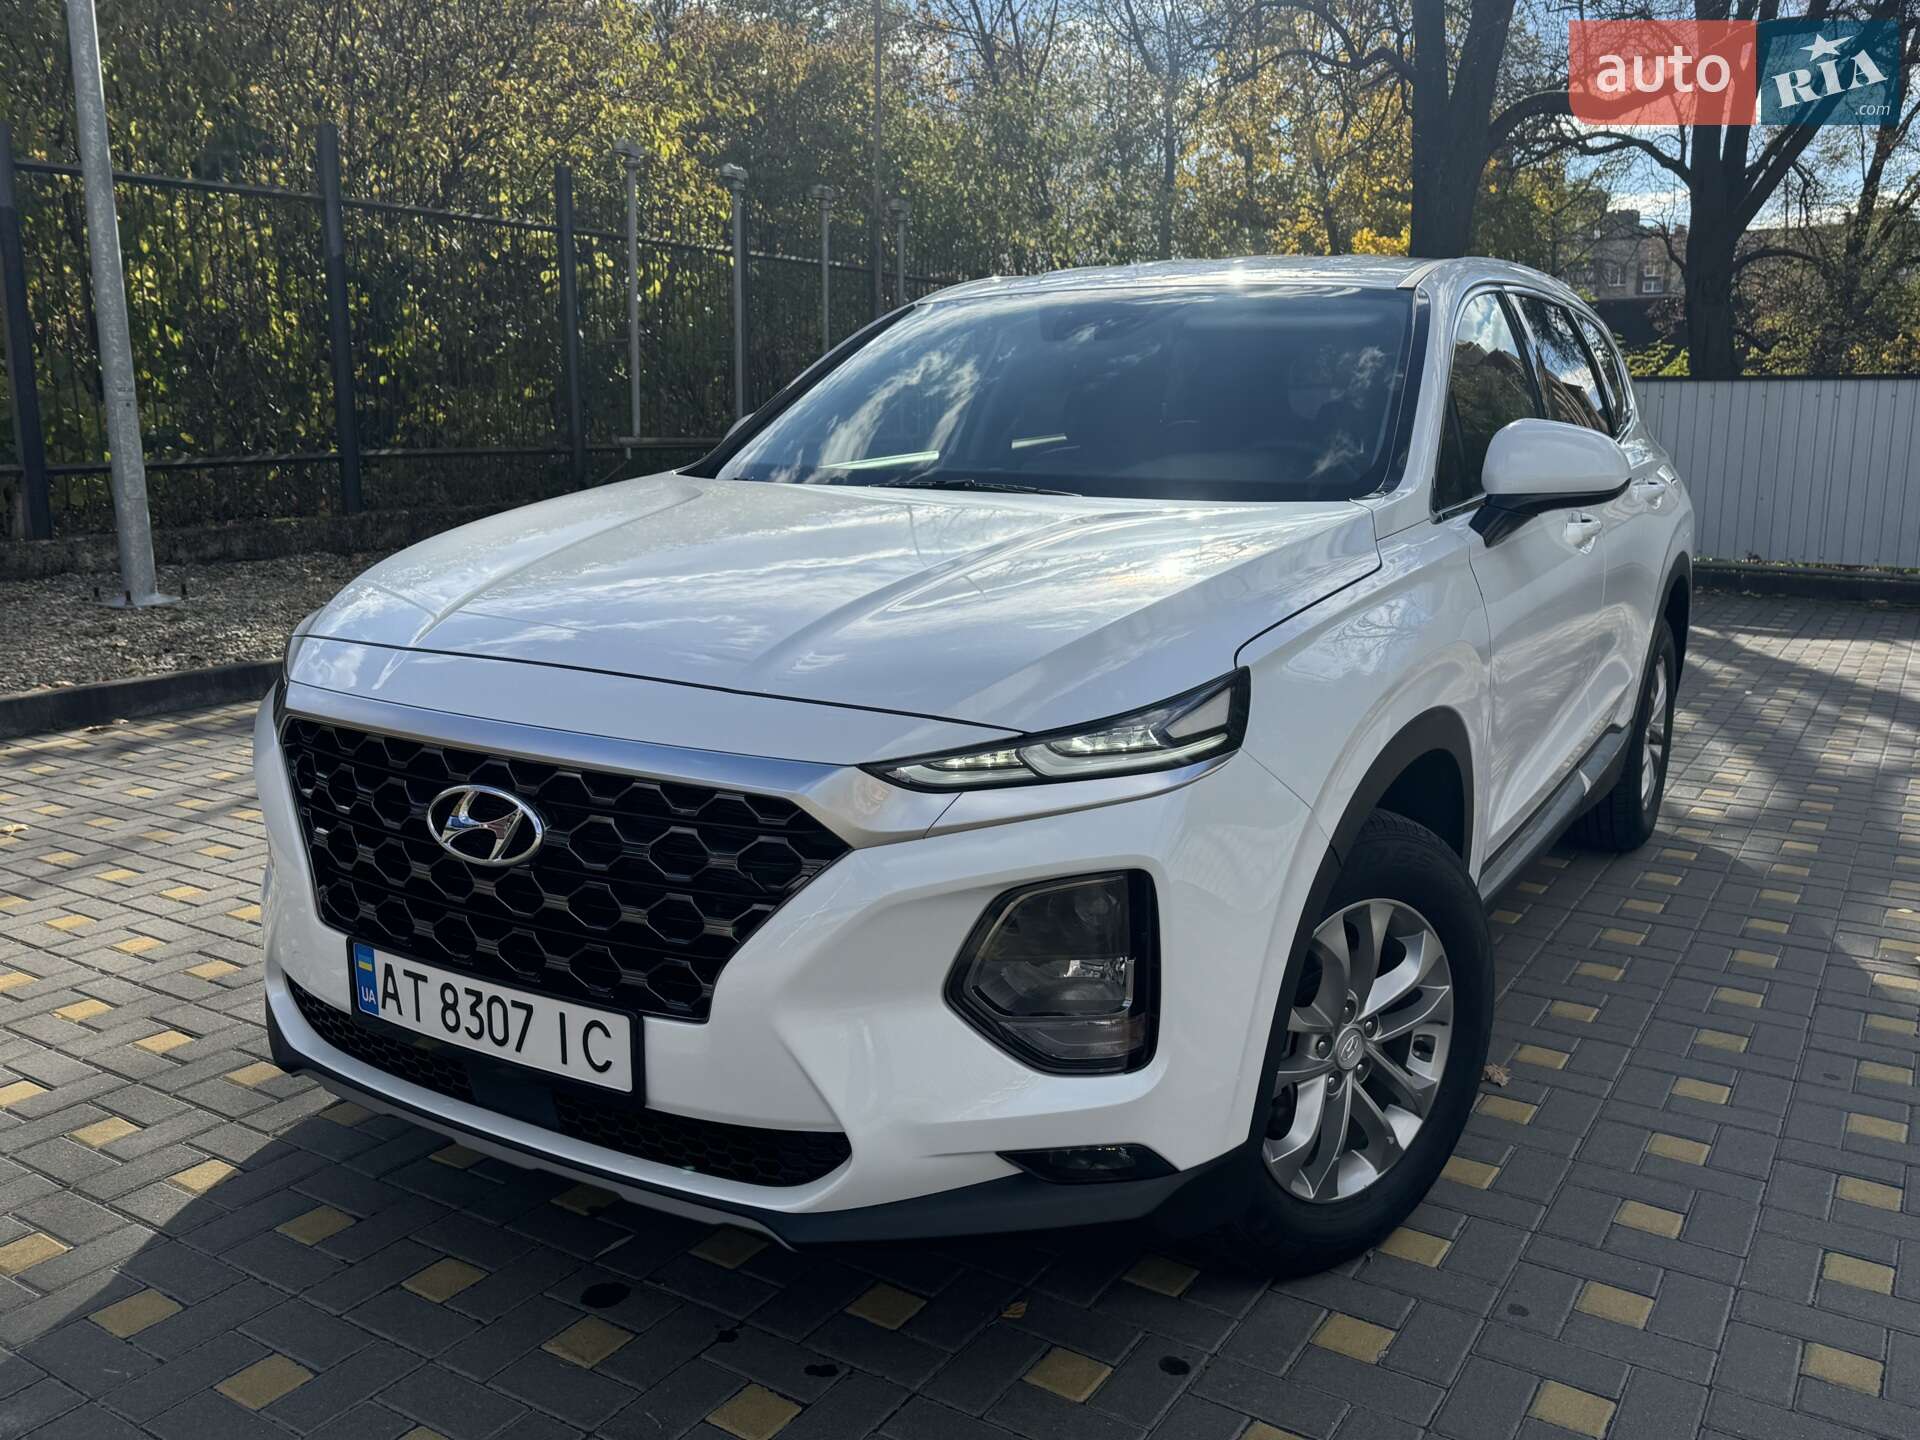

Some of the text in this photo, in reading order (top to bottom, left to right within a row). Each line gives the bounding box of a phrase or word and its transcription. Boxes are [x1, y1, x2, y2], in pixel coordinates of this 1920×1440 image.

[361, 985, 377, 1005] UA
[381, 963, 613, 1073] AT 8307 IC
